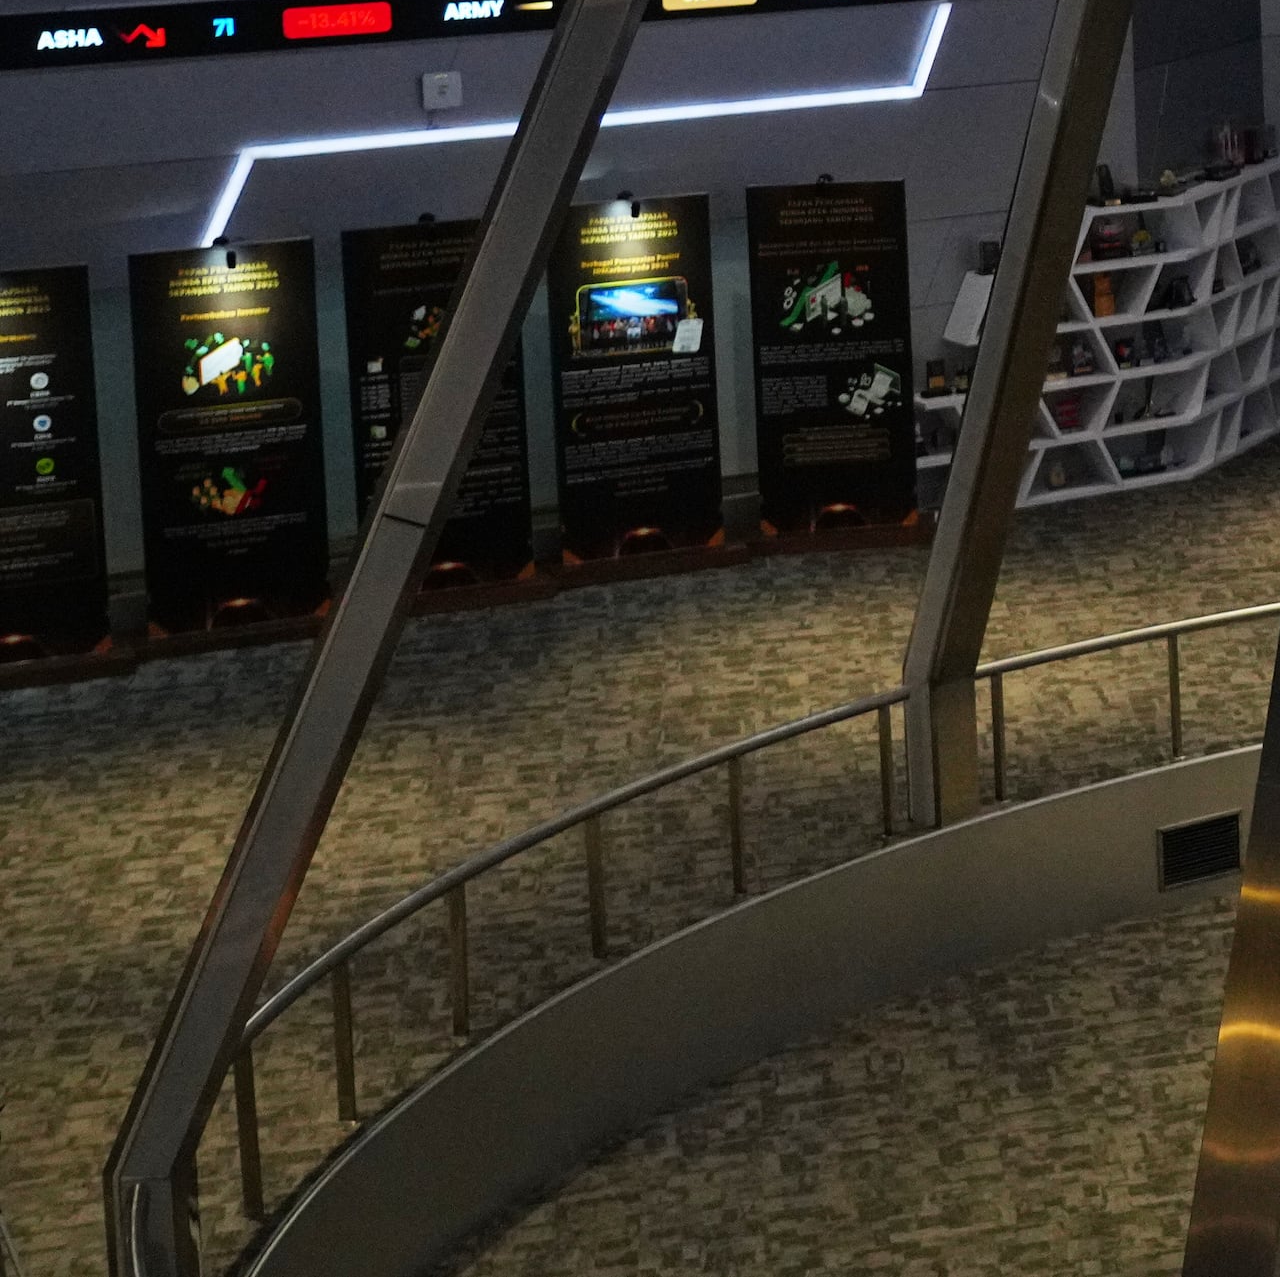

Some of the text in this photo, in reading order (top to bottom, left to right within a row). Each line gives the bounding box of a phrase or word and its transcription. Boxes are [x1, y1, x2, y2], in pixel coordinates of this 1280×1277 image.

[37, 27, 103, 50] ASHA
[212, 17, 235, 37] 71
[298, 10, 375, 29] -13.41%
[444, 0, 504, 21] ARMY
